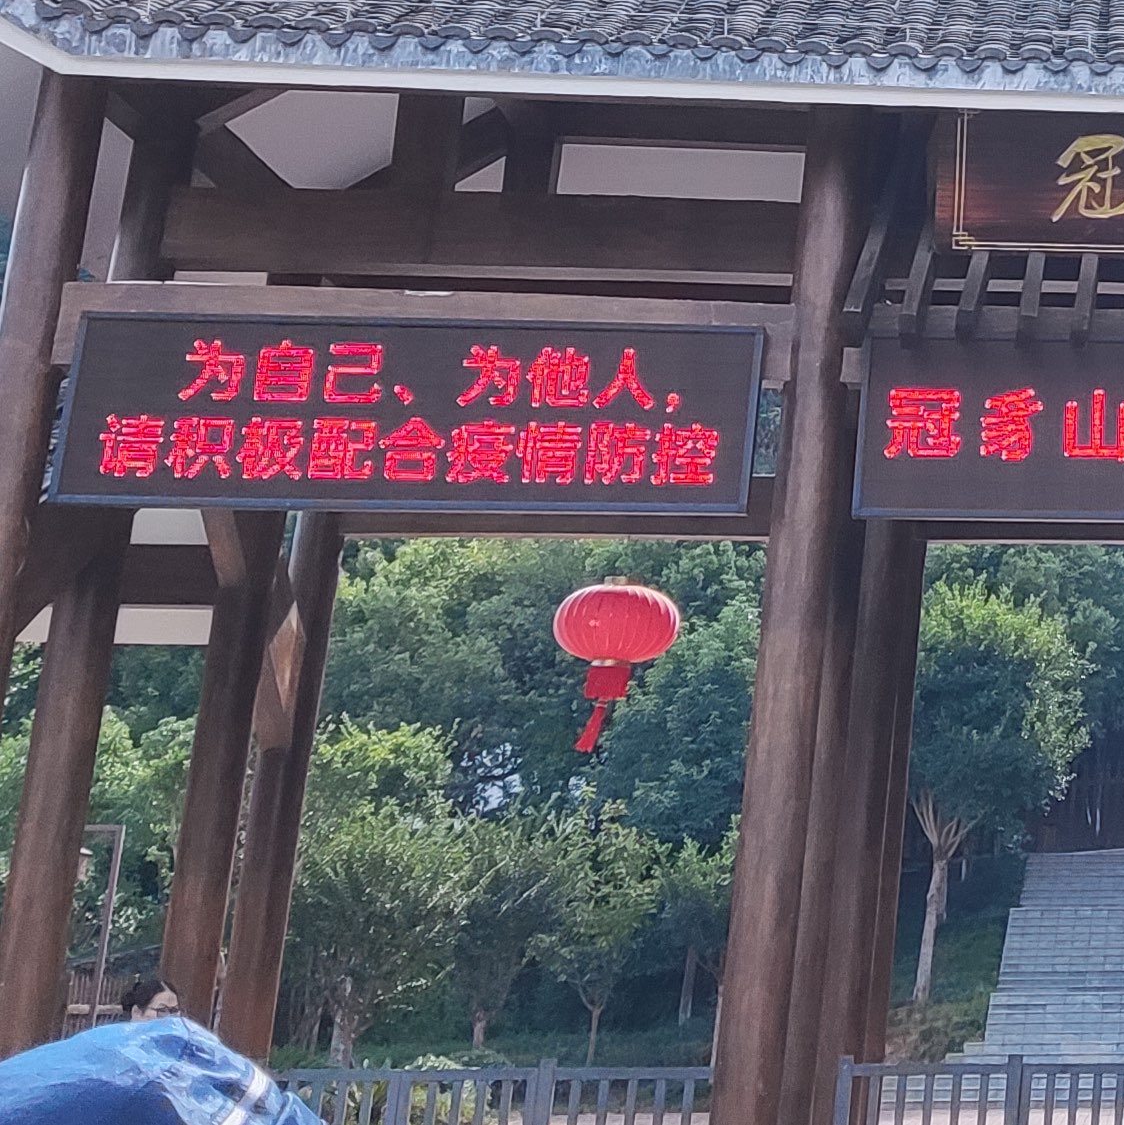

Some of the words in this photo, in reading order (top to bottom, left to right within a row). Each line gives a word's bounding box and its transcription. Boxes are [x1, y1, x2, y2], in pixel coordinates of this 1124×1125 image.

[99, 413, 720, 486] 请积极配合疫情防控
